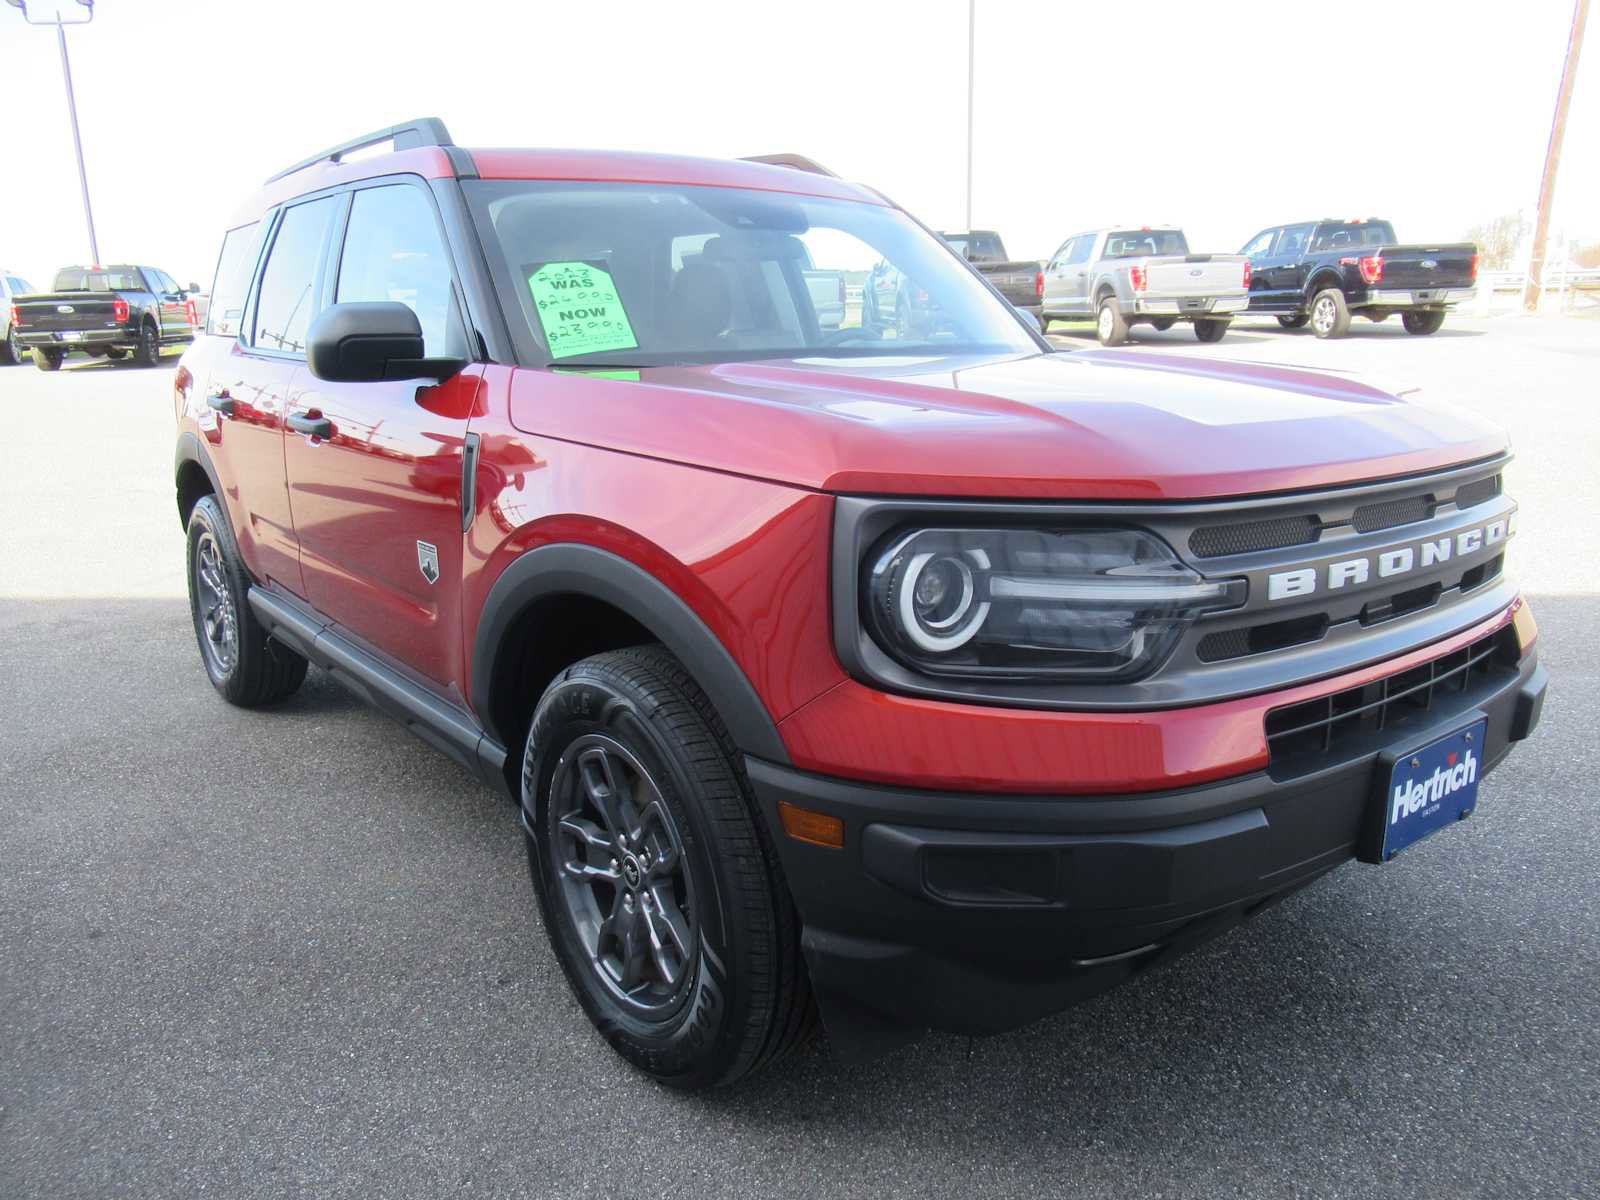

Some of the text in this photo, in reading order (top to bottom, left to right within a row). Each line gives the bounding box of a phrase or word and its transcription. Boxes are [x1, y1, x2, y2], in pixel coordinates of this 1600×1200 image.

[550, 279, 594, 290] WAS
[559, 307, 605, 321] NOW
[1268, 520, 1505, 601] BRONCO
[1391, 749, 1477, 825] Hertrich
